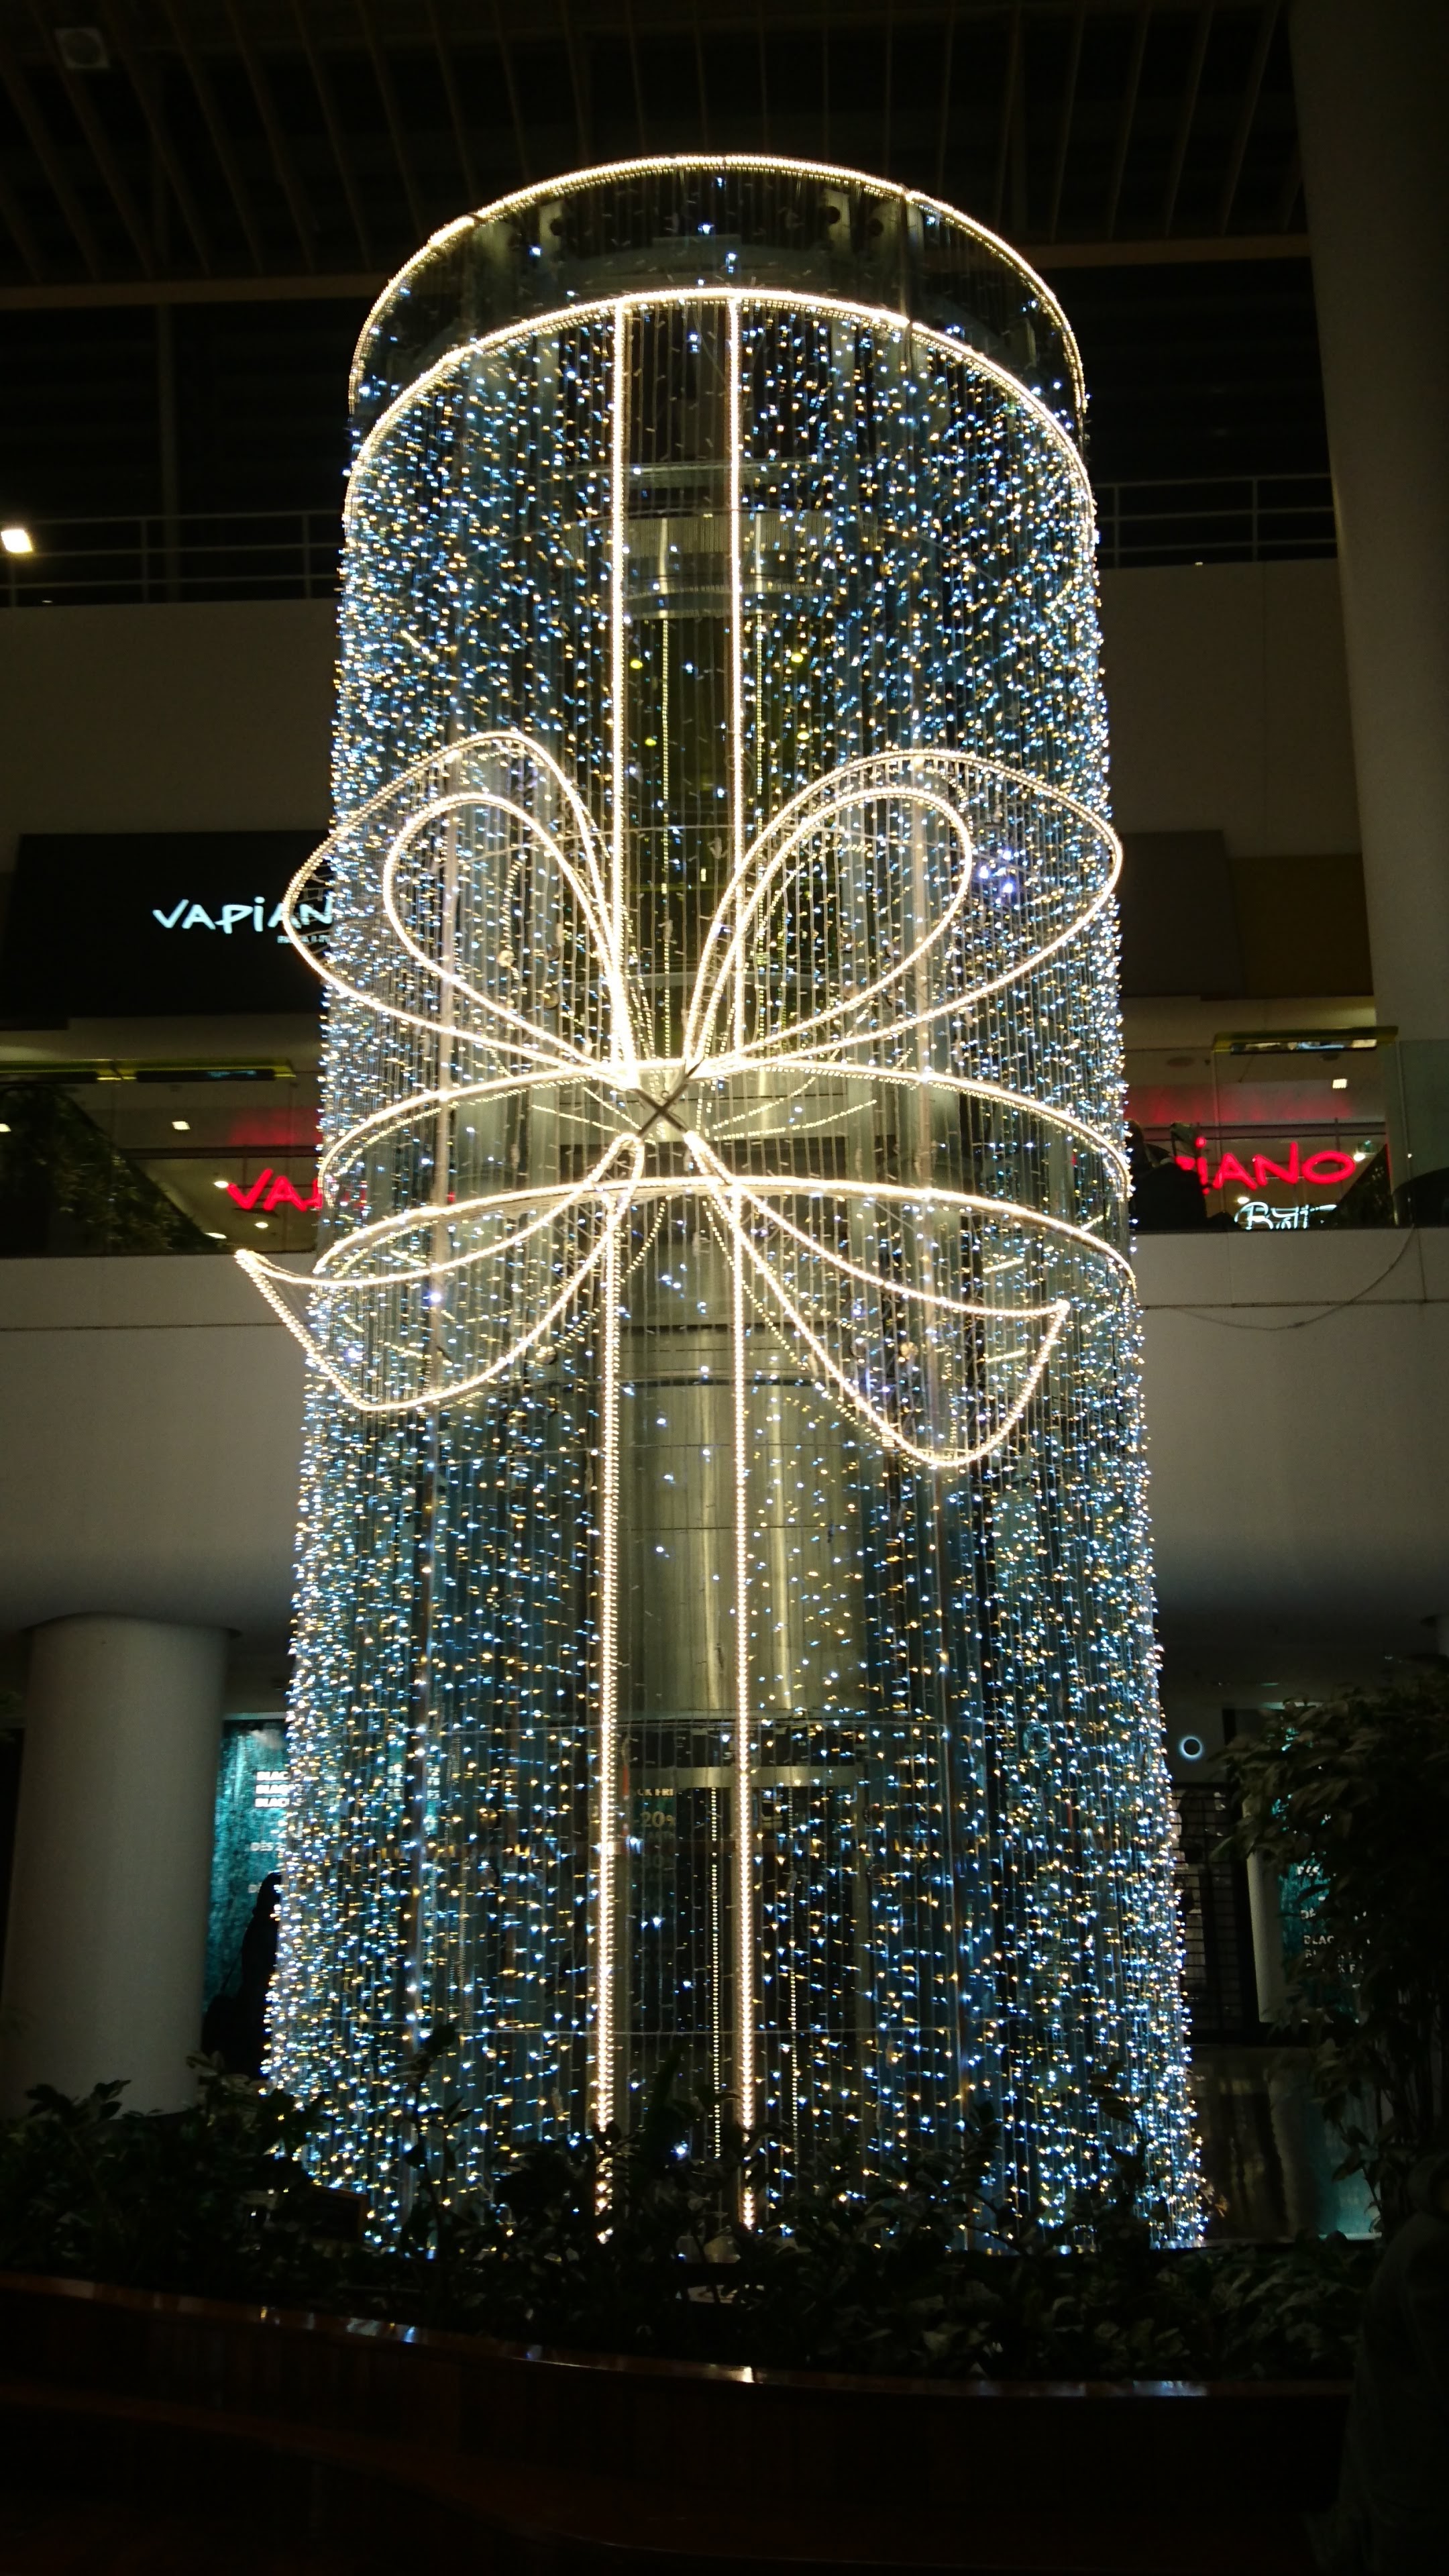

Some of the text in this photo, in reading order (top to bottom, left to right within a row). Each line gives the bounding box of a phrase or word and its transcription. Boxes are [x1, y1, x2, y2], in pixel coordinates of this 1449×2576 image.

[152, 896, 333, 934] VAPiAN
[256, 1771, 289, 1781] BLAC
[255, 1797, 290, 1807] BLAC
